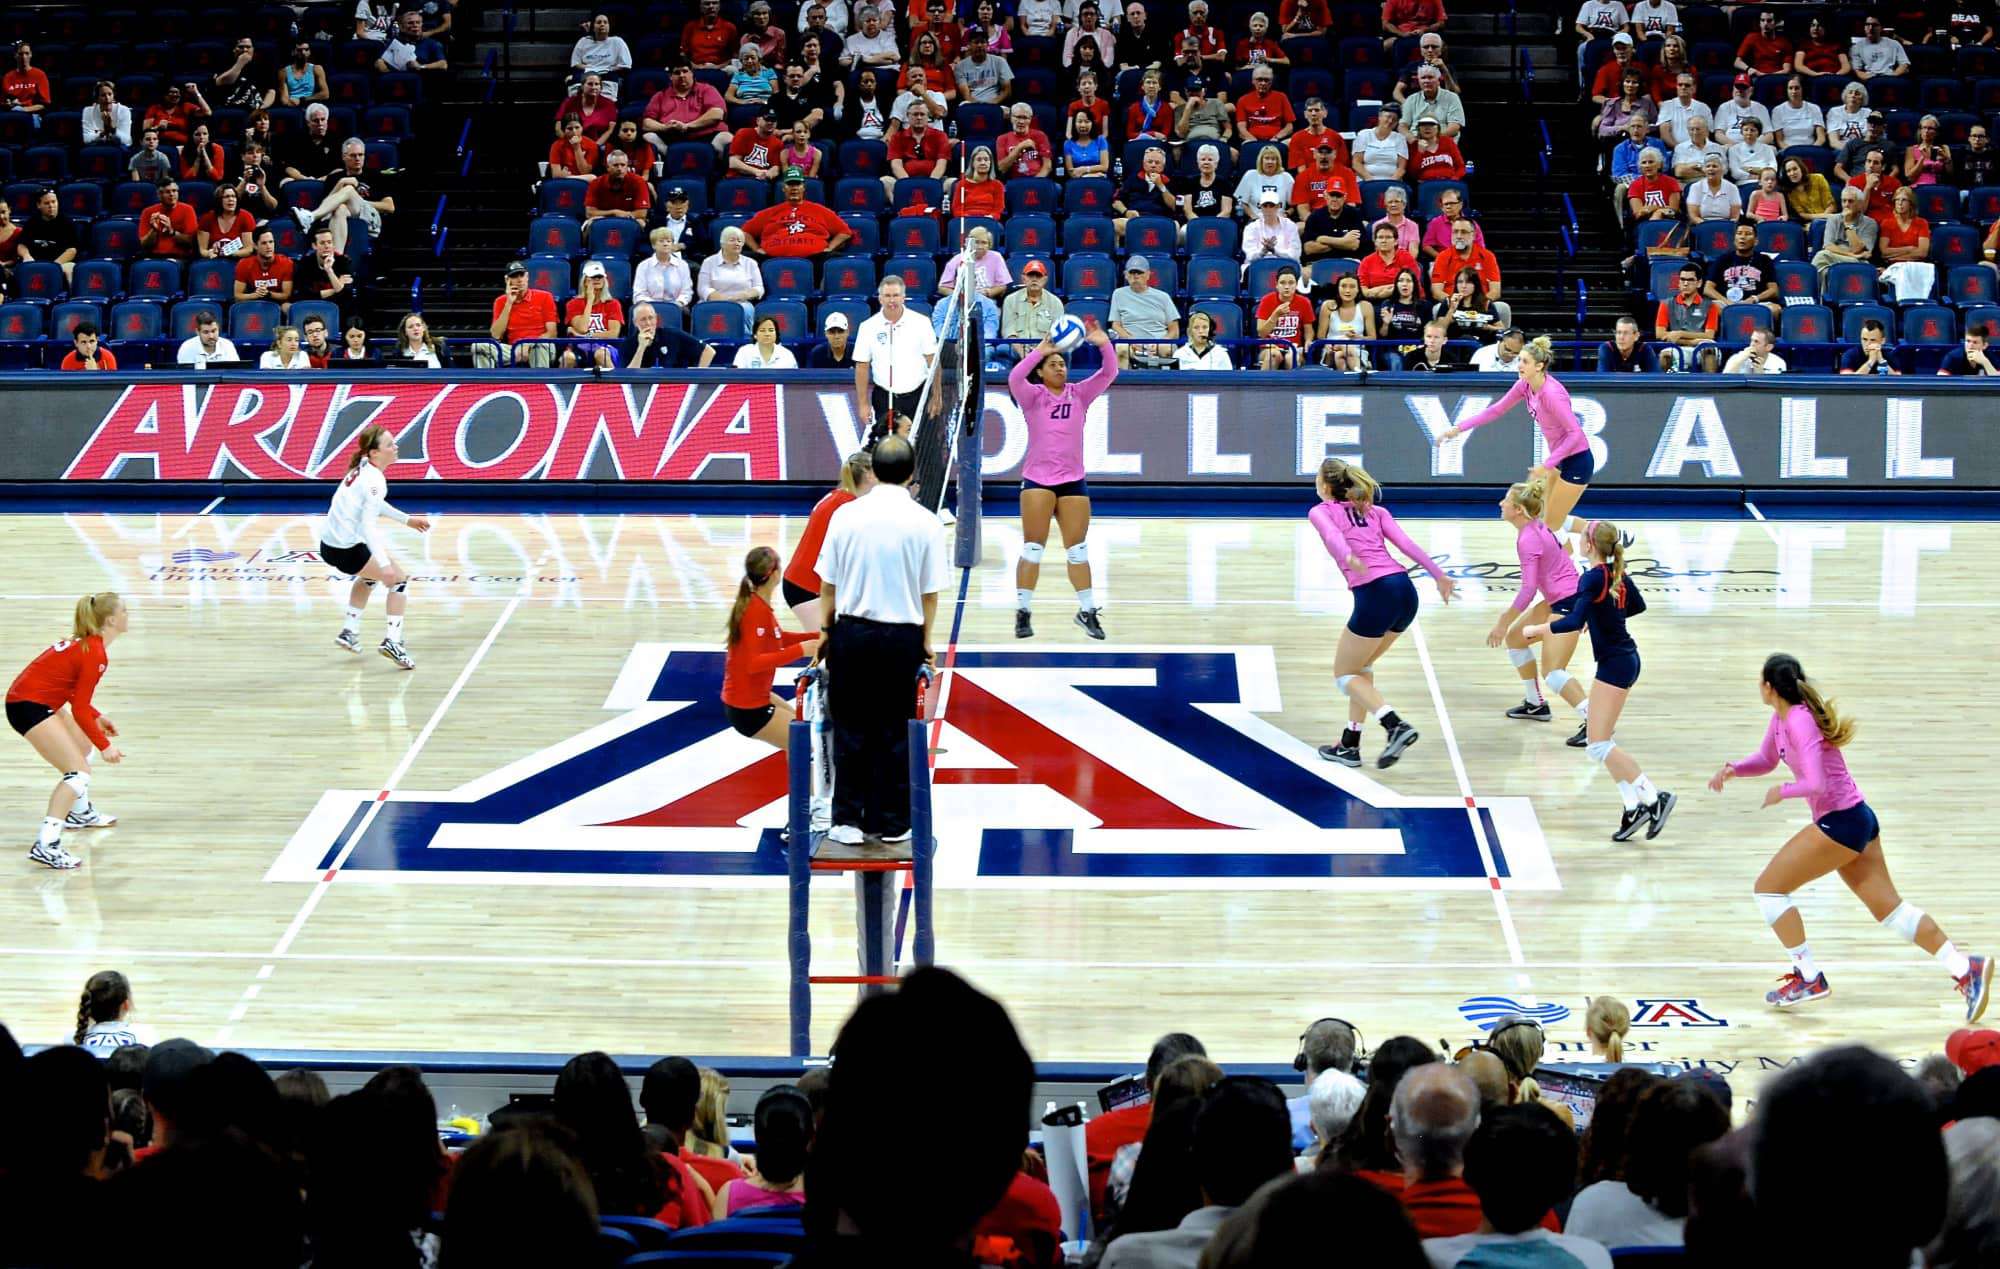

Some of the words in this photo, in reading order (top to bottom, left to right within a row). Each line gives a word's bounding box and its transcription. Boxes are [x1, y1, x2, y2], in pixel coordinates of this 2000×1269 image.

[743, 143, 770, 168] A
[1050, 403, 1072, 420] 20
[60, 383, 788, 481] ARIZONA
[149, 574, 319, 582] University
